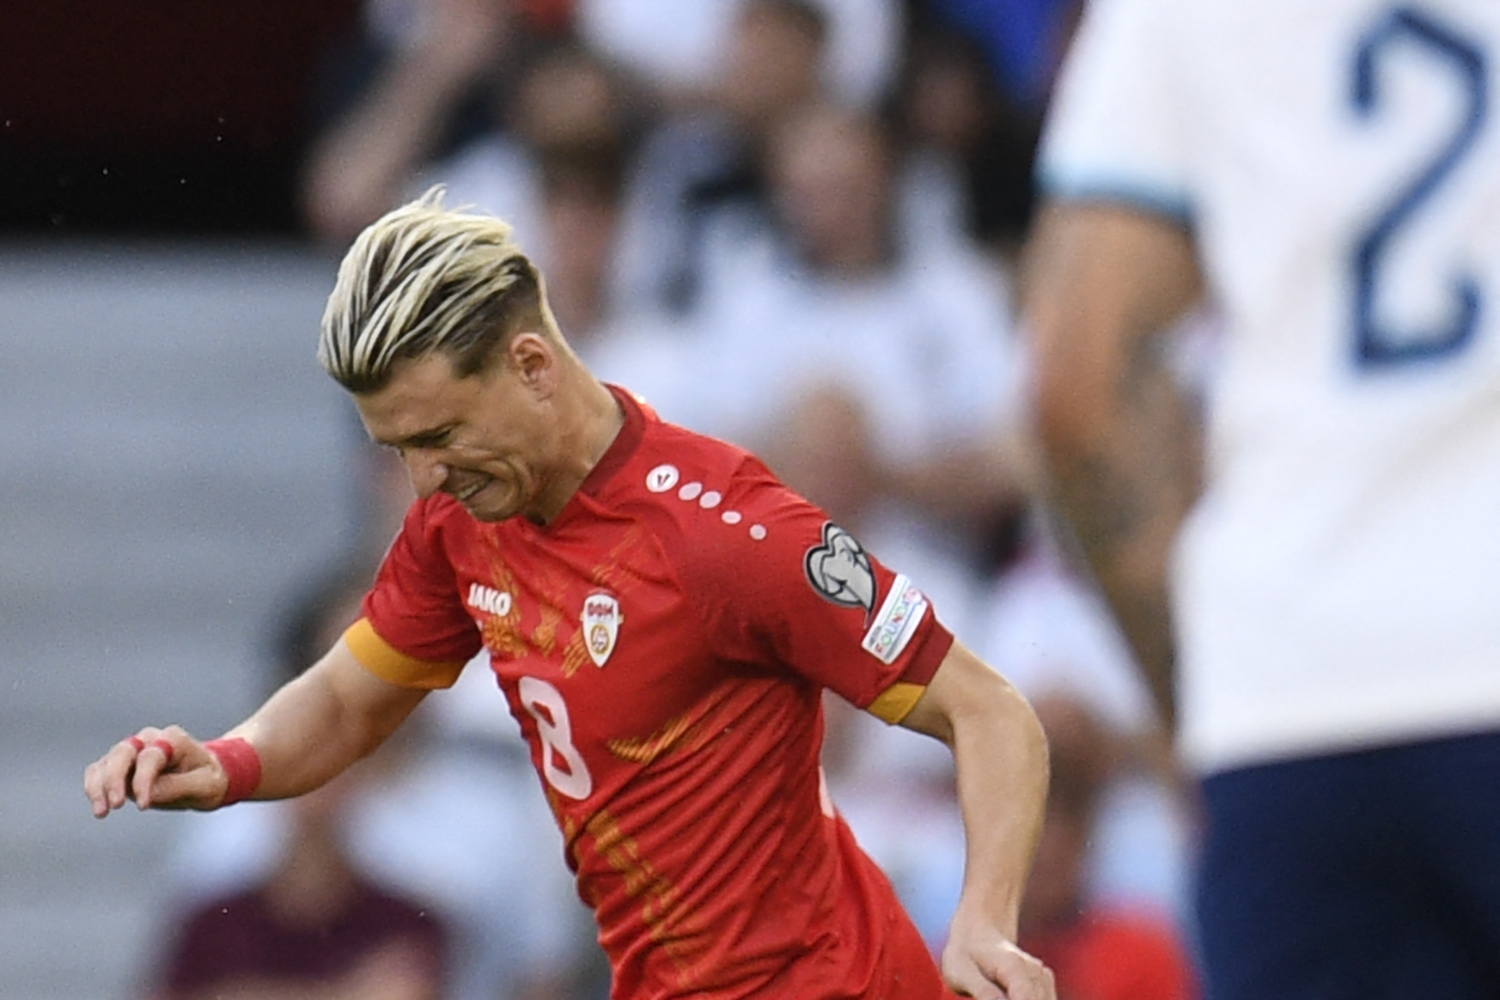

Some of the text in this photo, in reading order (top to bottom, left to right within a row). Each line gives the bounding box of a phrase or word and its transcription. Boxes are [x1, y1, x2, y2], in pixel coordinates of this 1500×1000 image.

[1351, 9, 1487, 371] 2
[468, 582, 512, 617] JAKO
[518, 675, 592, 801] 8
